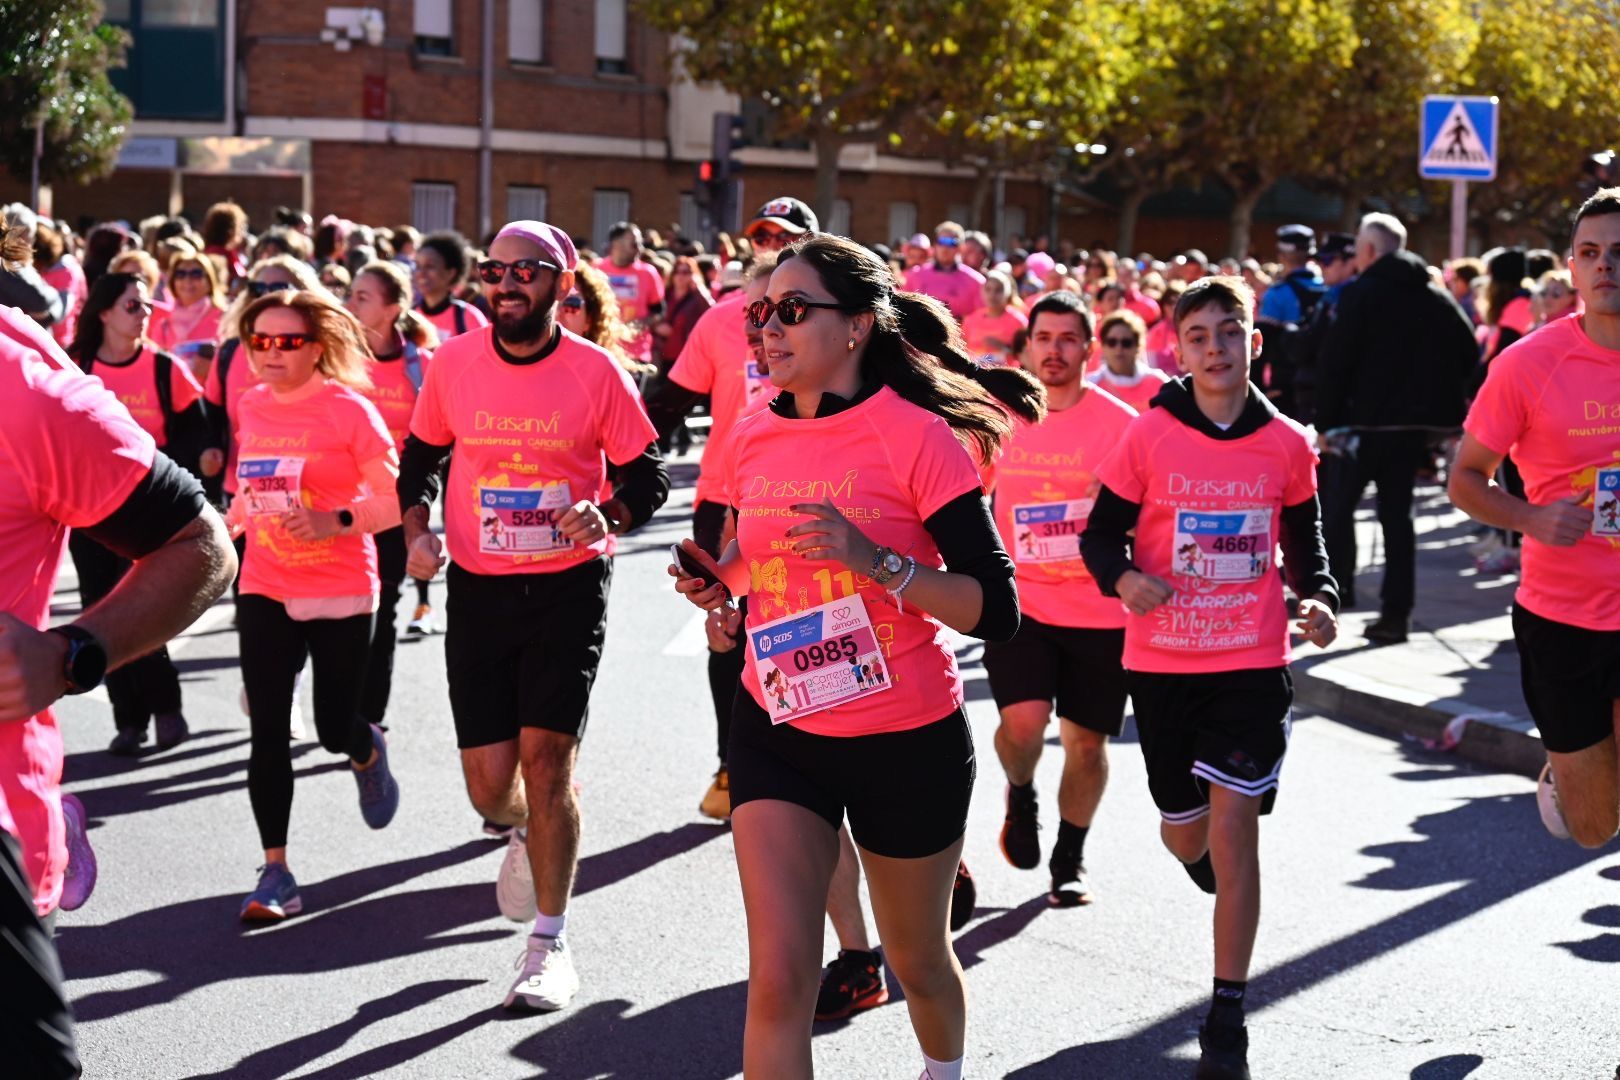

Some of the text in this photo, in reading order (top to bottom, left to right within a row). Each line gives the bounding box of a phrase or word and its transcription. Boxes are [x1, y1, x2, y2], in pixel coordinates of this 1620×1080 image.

[258, 477, 287, 491] 3732
[748, 470, 858, 498] Drasanvi
[1168, 472, 1269, 498] Drasanvi
[1043, 521, 1076, 536] 3171
[1212, 536, 1258, 553] 4667
[831, 618, 861, 631] almom
[1168, 610, 1238, 638] Mujer
[793, 635, 858, 671] 0985
